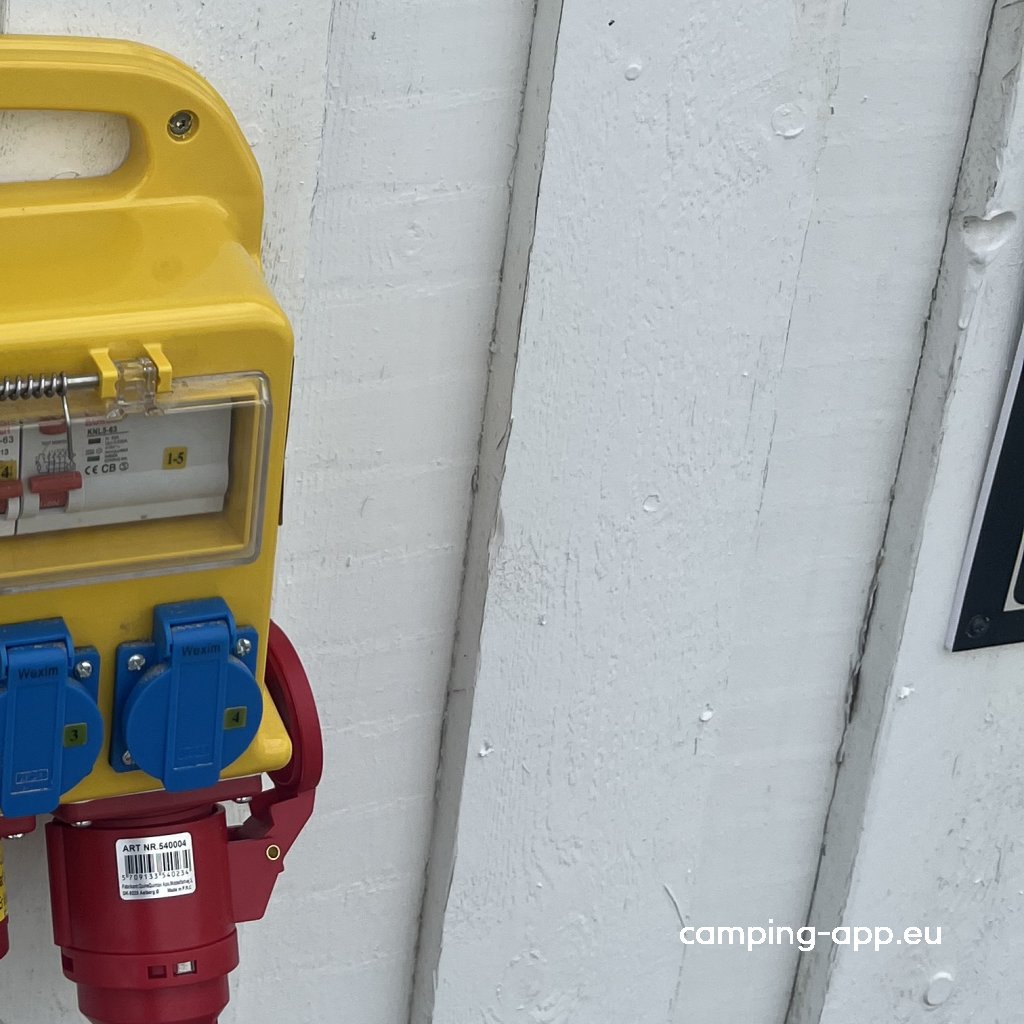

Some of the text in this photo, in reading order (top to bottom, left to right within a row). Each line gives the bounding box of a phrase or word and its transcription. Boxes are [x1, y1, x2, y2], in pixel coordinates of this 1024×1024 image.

[168, 451, 184, 464] 1-5
[102, 464, 116, 474] CB
[182, 644, 221, 657] Wexim
[18, 666, 58, 680] Wexim
[70, 730, 78, 742] 3
[122, 844, 140, 852] ART
